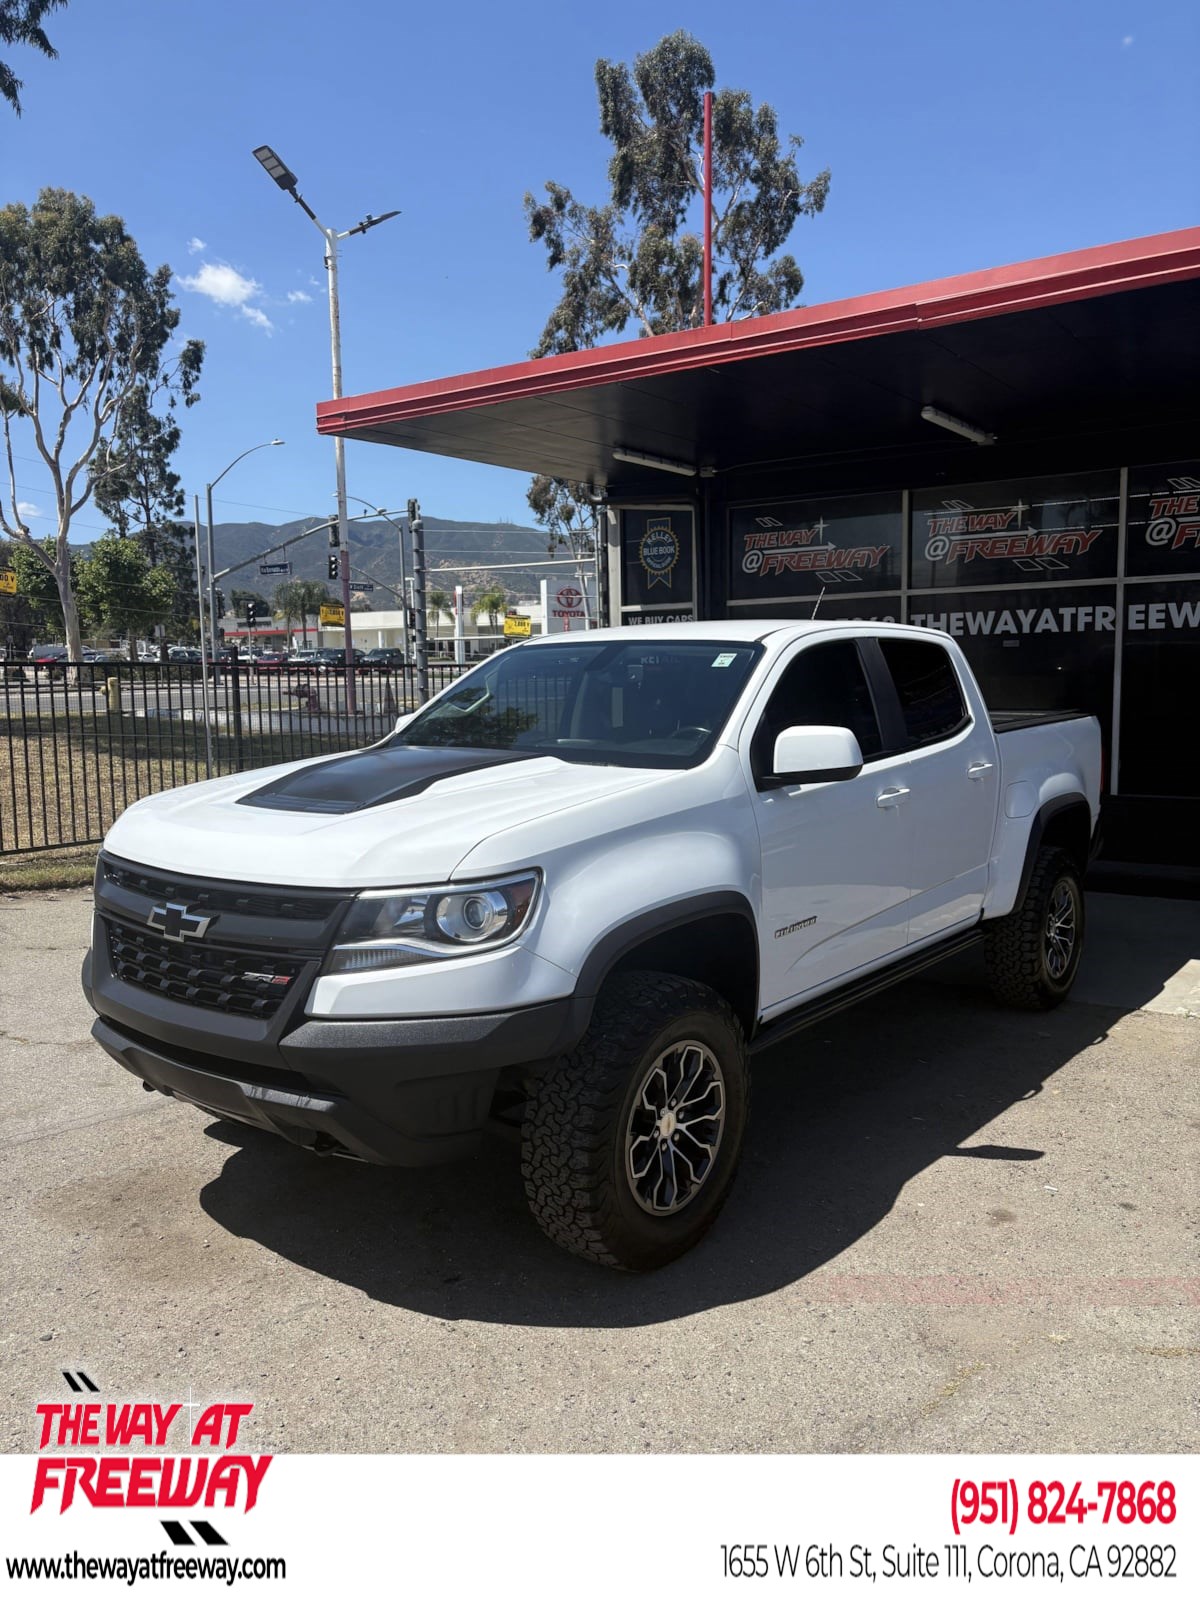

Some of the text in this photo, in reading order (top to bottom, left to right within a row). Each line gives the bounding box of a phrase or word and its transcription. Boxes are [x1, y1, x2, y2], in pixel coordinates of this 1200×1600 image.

[968, 511, 1017, 531] WAY
[646, 531, 673, 545] KELLEY
[778, 528, 819, 547] WAY
[643, 545, 675, 556] BLUE BOOK
[552, 609, 586, 618] TOYOTA
[645, 615, 664, 625] BUY
[666, 614, 694, 624] CARS
